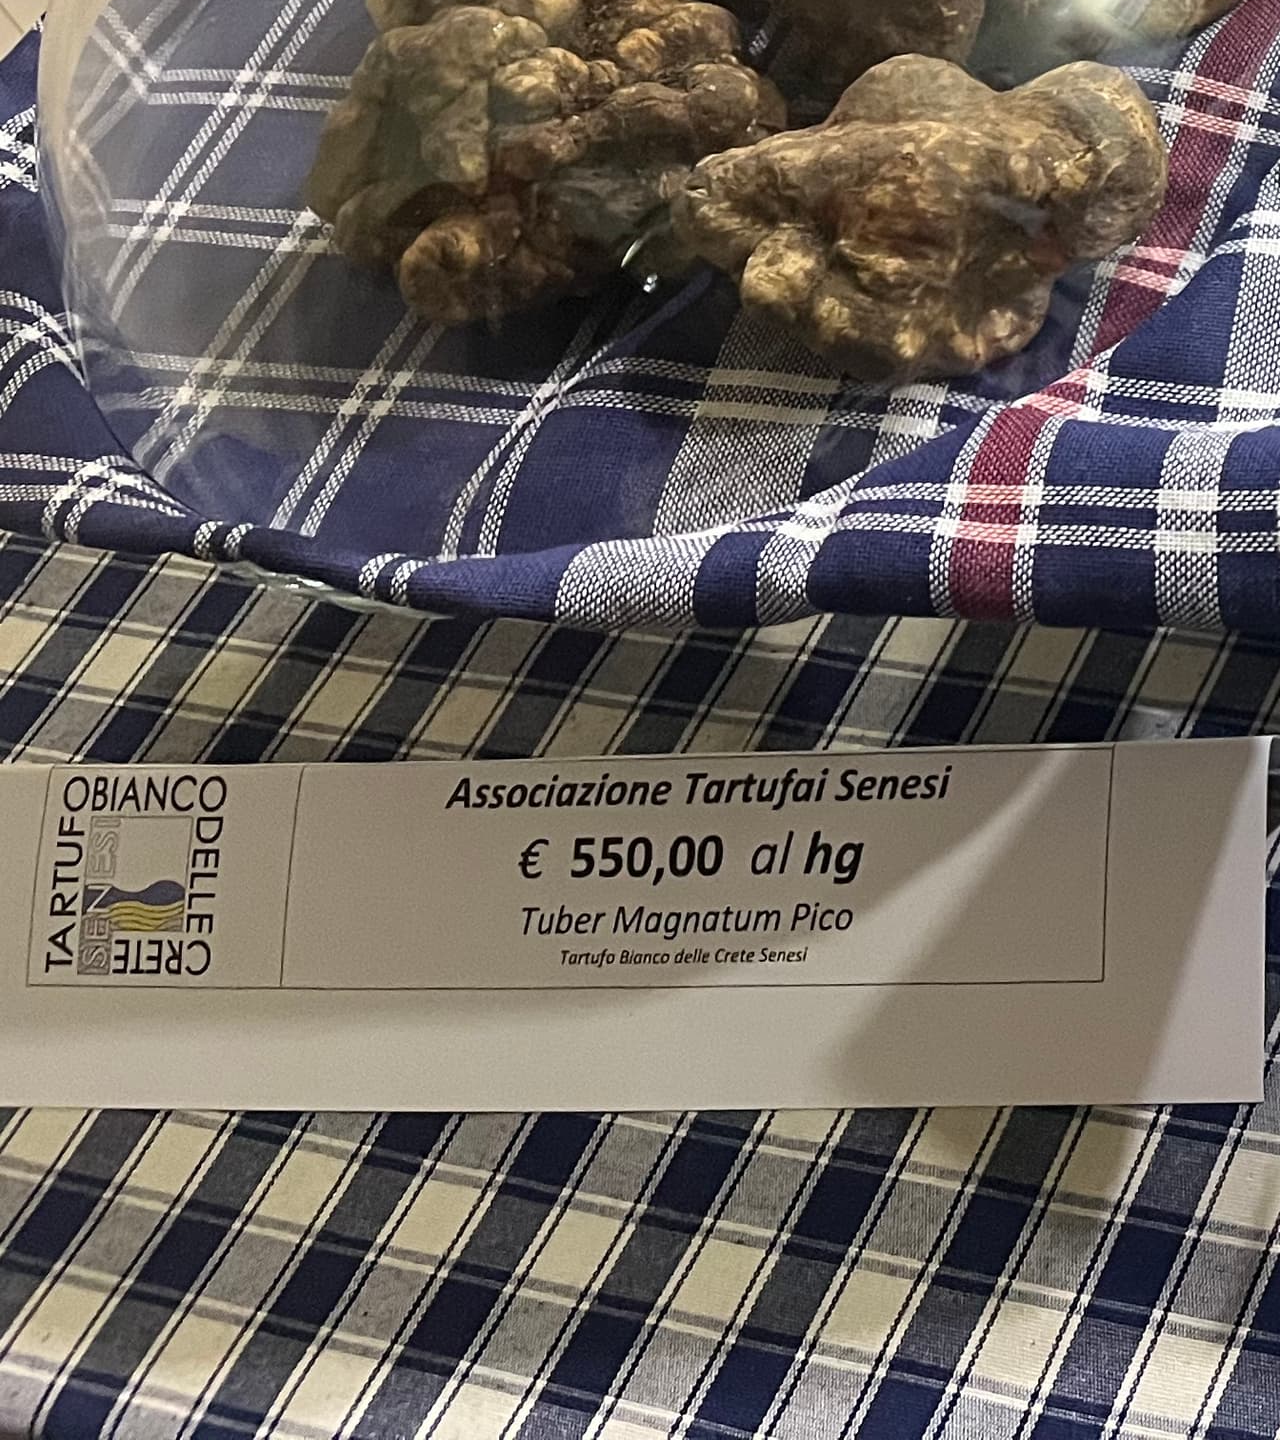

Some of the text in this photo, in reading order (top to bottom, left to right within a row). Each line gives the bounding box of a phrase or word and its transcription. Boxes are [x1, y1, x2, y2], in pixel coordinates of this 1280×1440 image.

[444, 764, 953, 811] Associazione Tartufai Senesi
[186, 816, 224, 934] DELLE
[517, 830, 865, 887] € 550,00 al hg
[521, 901, 855, 941] Tuber Magnatum Pico
[112, 939, 212, 976] CRETE
[560, 946, 809, 969] Tartufo Bianco delle Crete Senesi
